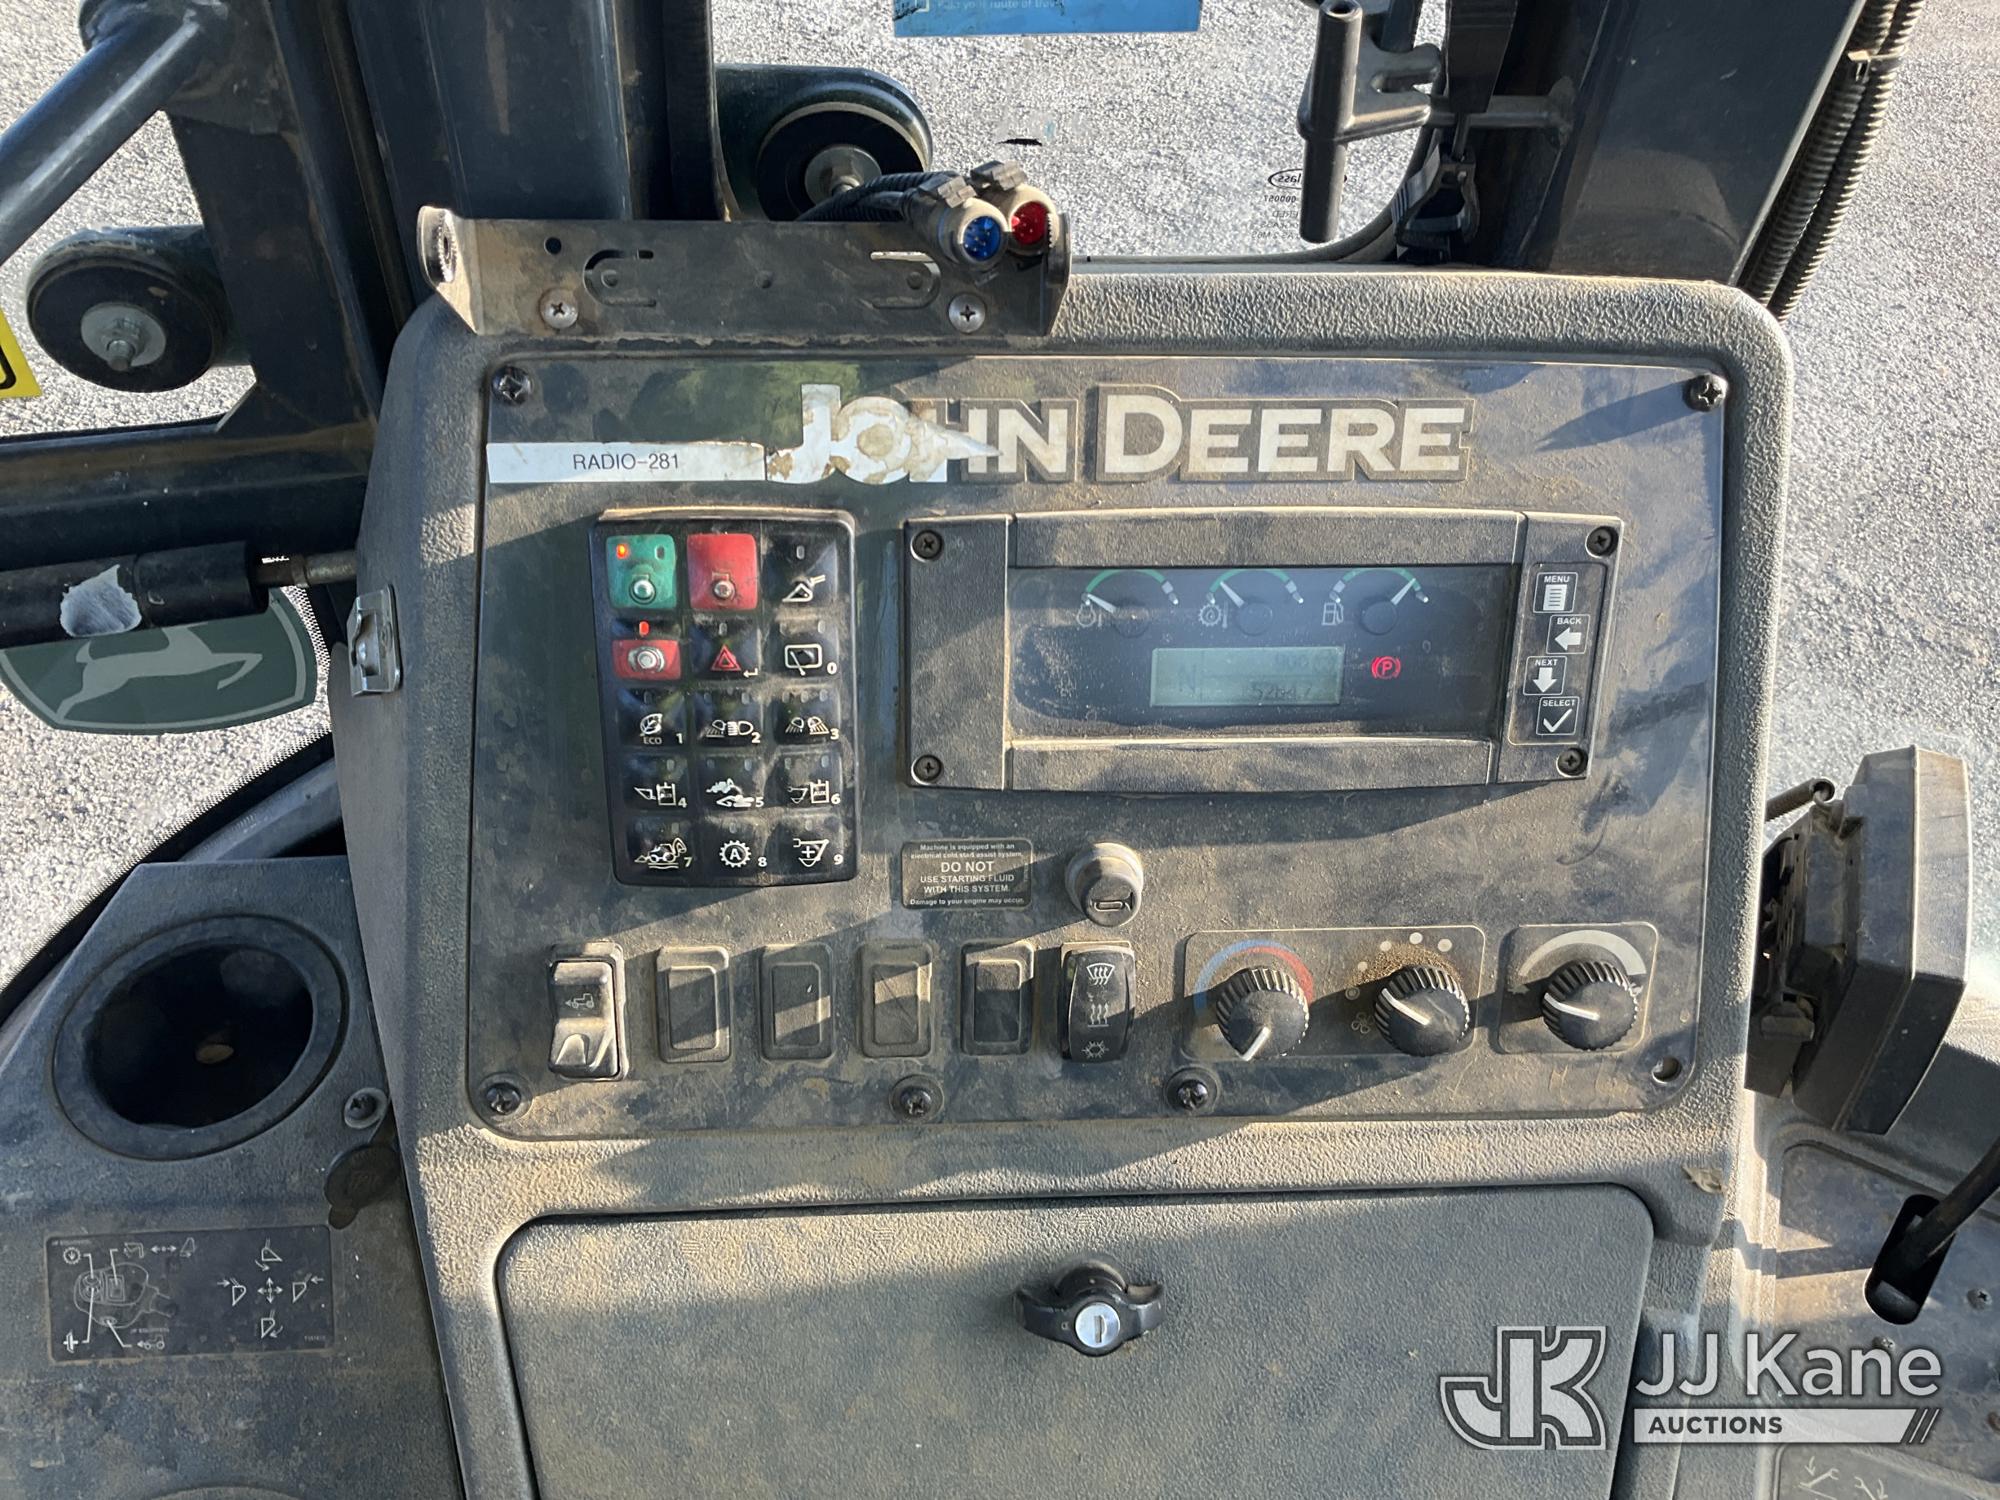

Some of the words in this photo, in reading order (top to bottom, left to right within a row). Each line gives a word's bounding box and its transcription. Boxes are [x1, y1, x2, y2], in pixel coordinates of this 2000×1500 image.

[765, 384, 1070, 483] JOHN
[1105, 391, 1466, 475] DEERE
[572, 452, 680, 472] RADIO-281
[1544, 575, 1570, 583] MENU
[1556, 617, 1582, 625] BACK
[1534, 658, 1559, 667] NEXT
[1542, 699, 1576, 707] SELECT
[676, 733, 684, 745] 1
[751, 733, 761, 745] 2
[830, 728, 840, 740] 3
[643, 737, 663, 746] ECO
[677, 797, 688, 809] 4
[754, 797, 765, 808] 5
[830, 793, 841, 805] 6
[919, 843, 949, 851] Machine
[957, 843, 989, 851] equipped
[729, 848, 740, 860] A
[684, 857, 694, 868] 7
[757, 856, 768, 868] 8
[833, 854, 844, 866] 9
[940, 861, 962, 873] DO
[964, 860, 995, 873] NOT
[920, 875, 939, 883] USE
[941, 874, 986, 883] STARTING
[988, 874, 1015, 882] FLUID
[923, 885, 947, 894] WITH
[948, 885, 970, 893] THIS
[971, 884, 1011, 893] SYSTEM.
[909, 898, 938, 906] Damage
[947, 898, 963, 906] your
[988, 897, 1003, 905] may
